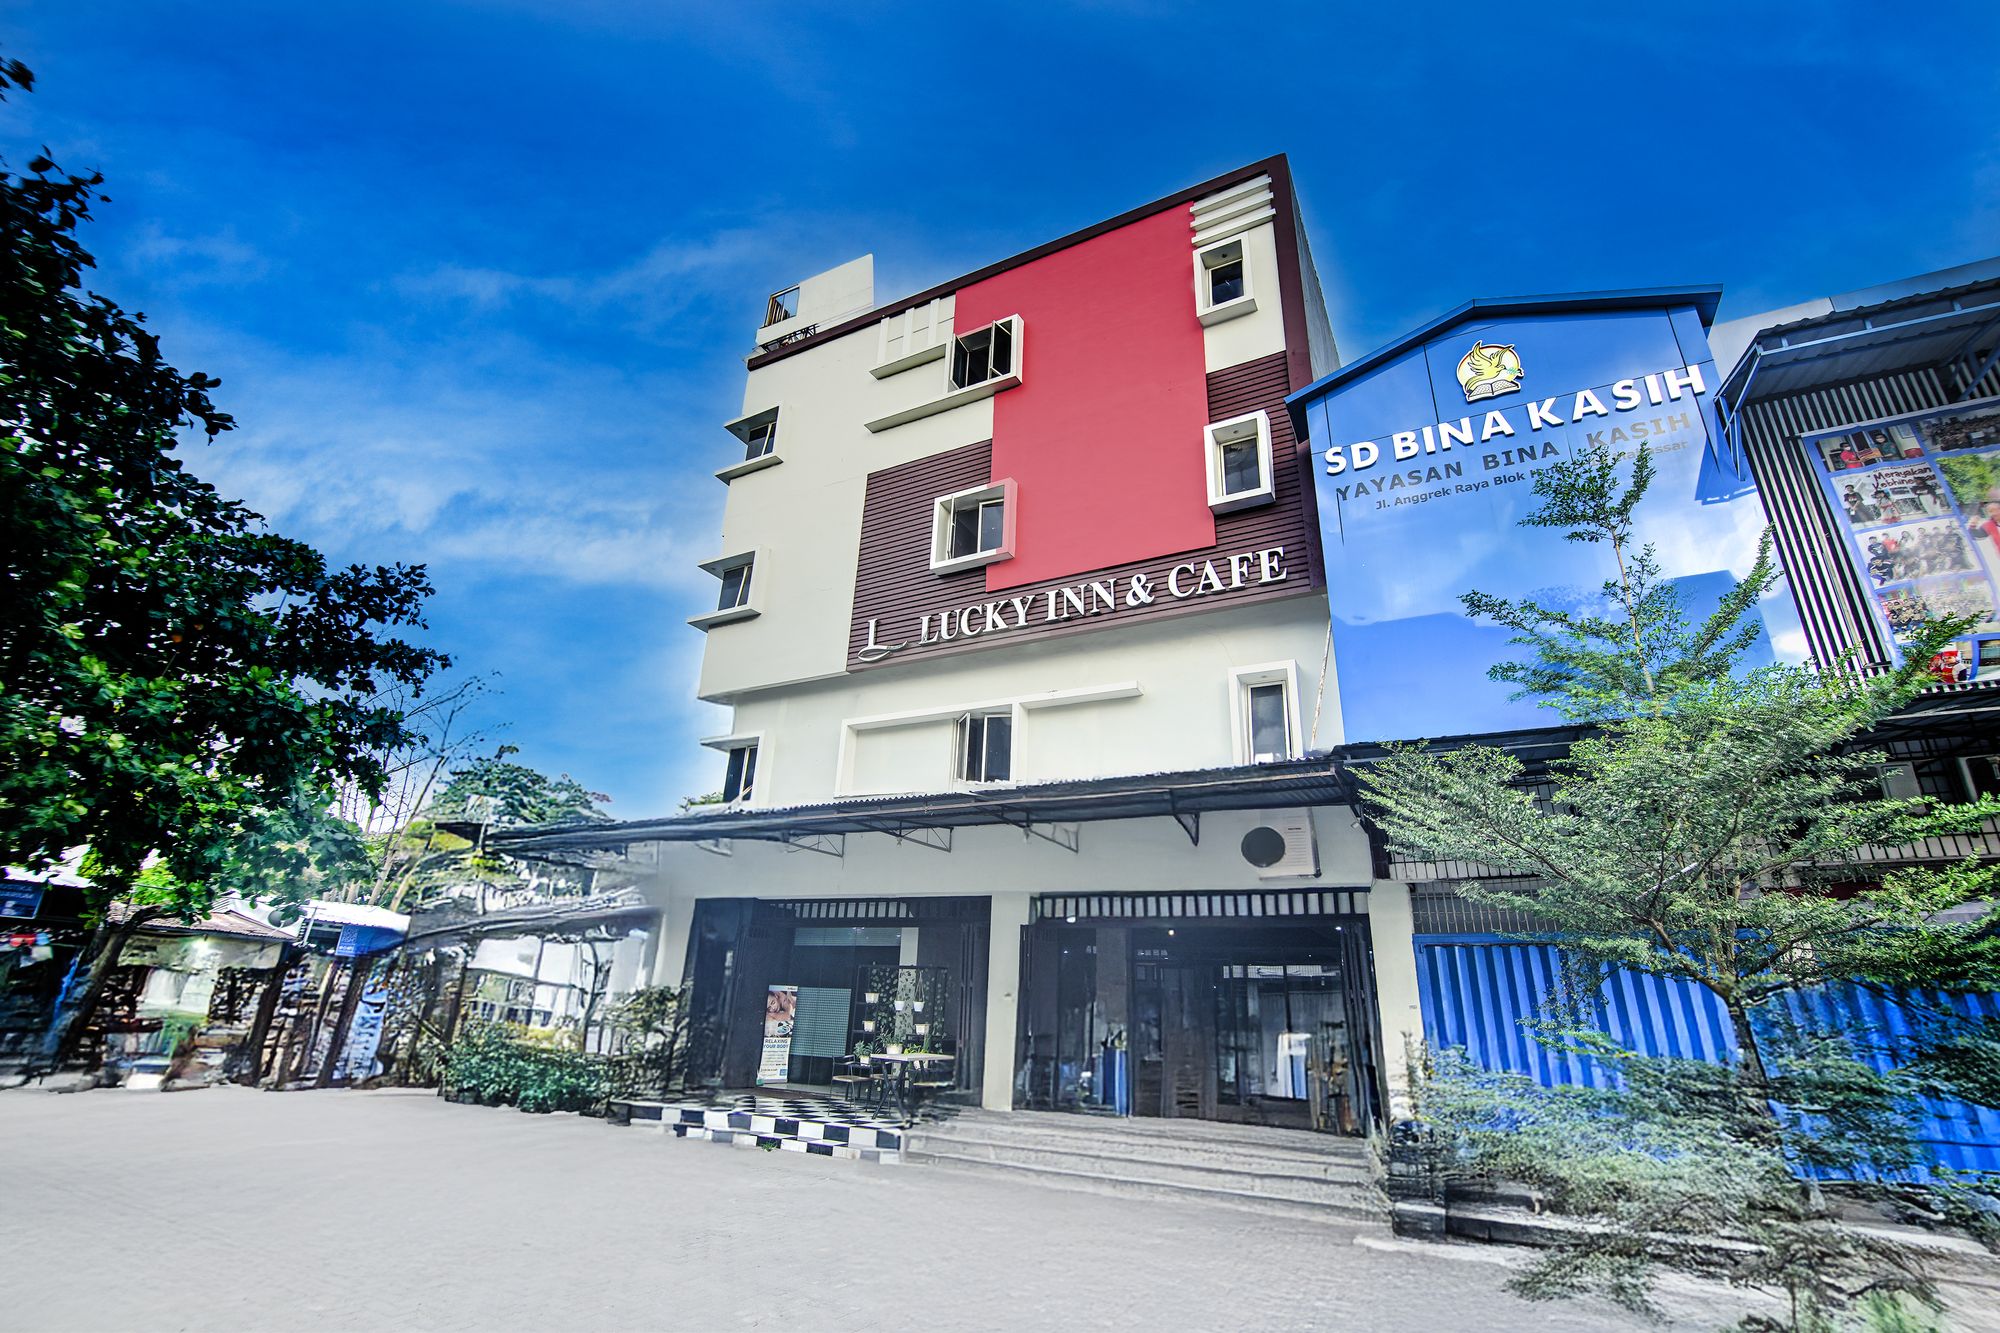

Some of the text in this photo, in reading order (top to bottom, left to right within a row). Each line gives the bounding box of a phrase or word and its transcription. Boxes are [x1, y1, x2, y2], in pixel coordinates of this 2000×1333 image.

[1324, 364, 1706, 475] SD BINA KASIH
[1336, 412, 1691, 501] YAYASAN BINA KASIH
[1375, 499, 1391, 510] Jl.
[1394, 487, 1452, 507] Anggrek
[1454, 480, 1490, 494] Raya
[1493, 471, 1526, 486] Blok
[1873, 467, 1932, 481] Merayakan
[918, 594, 1036, 645] LUCKY
[1044, 578, 1118, 623] INN
[1125, 573, 1155, 607] &
[1168, 546, 1289, 599] CAFE
